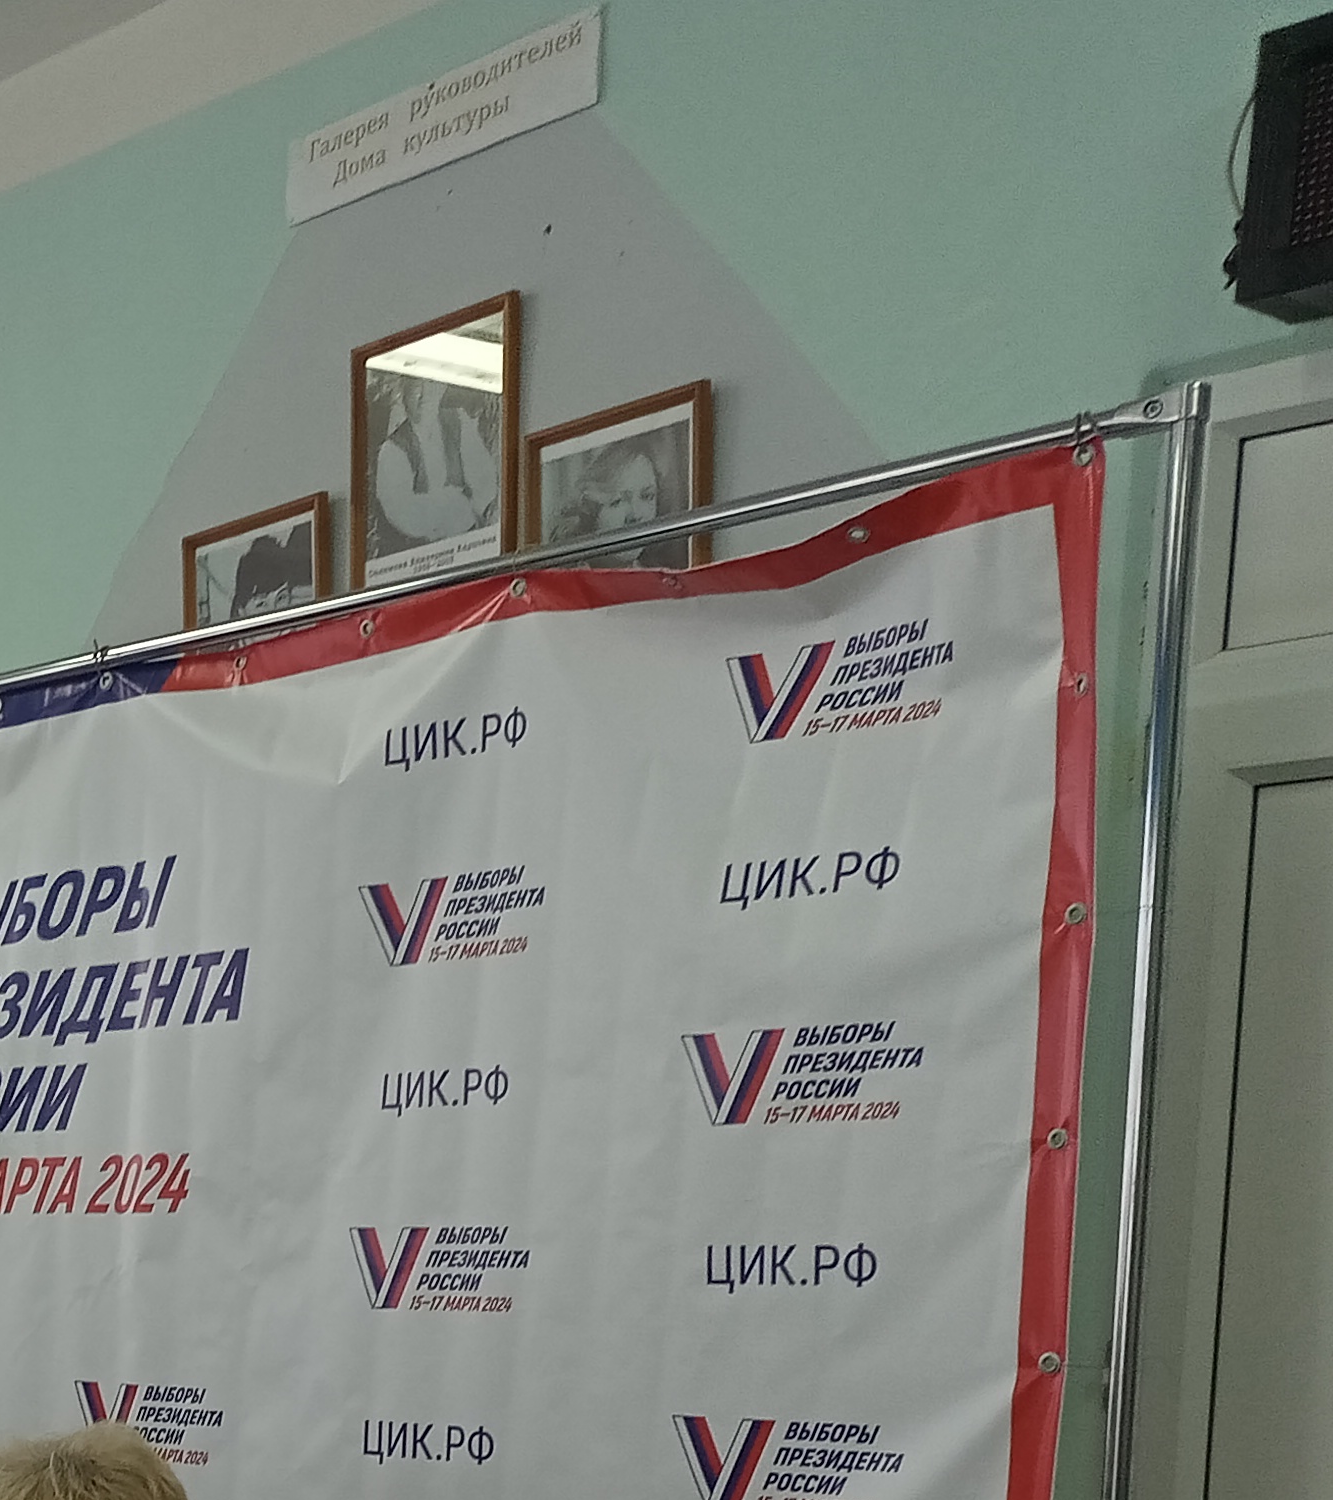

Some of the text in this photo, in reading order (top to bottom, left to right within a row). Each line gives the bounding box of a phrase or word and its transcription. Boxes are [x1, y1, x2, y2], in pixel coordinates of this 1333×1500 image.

[309, 21, 583, 163] Галерея руководителей
[333, 94, 510, 188] Дома культуры
[843, 619, 928, 657] ВЫБОРЫ
[830, 641, 954, 686] ПРЕЗИДЕНТА
[814, 680, 904, 713] РОССИИ
[847, 707, 903, 730] МАРТА
[902, 698, 942, 723] 2024
[383, 707, 528, 773] ЦИК.РФ
[452, 865, 525, 893] ВЫБОРЫ
[720, 845, 901, 911] ЦИК.РФ
[444, 886, 545, 917] ПРЕЗИДЕНТА
[434, 917, 501, 942] РОССИИ
[459, 940, 499, 959] МАРТА
[499, 936, 528, 955] 2024
[793, 1021, 895, 1047] ВЫБОРЫ
[782, 1047, 924, 1075] ПРЕЗИДЕНТА
[380, 1065, 510, 1117] ЦИК.РФ
[771, 1077, 862, 1101] РОССИИ
[806, 1103, 861, 1123] МАРТА
[861, 1101, 900, 1120] 2024
[84, 1152, 191, 1214] 2024
[435, 1226, 508, 1244] ВЫБОРЫ
[425, 1250, 530, 1270] ПРЕЗИДЕНТА
[705, 1243, 878, 1294] ЦИК.РФ
[416, 1273, 483, 1291] РОССИИ
[443, 1296, 481, 1312] МАРТА
[481, 1297, 512, 1312] 2024
[143, 1385, 206, 1404] ВЫБОРЫ
[136, 1406, 223, 1427] ПРЕЗИДЕНТА
[362, 1419, 495, 1466] ЦИК.РФ
[784, 1421, 880, 1445] ВЫБОРЫ
[184, 1450, 209, 1466] 2024
[773, 1447, 904, 1472] ПРЕЗИДЕНТА
[763, 1473, 847, 1495] РОССИИ
